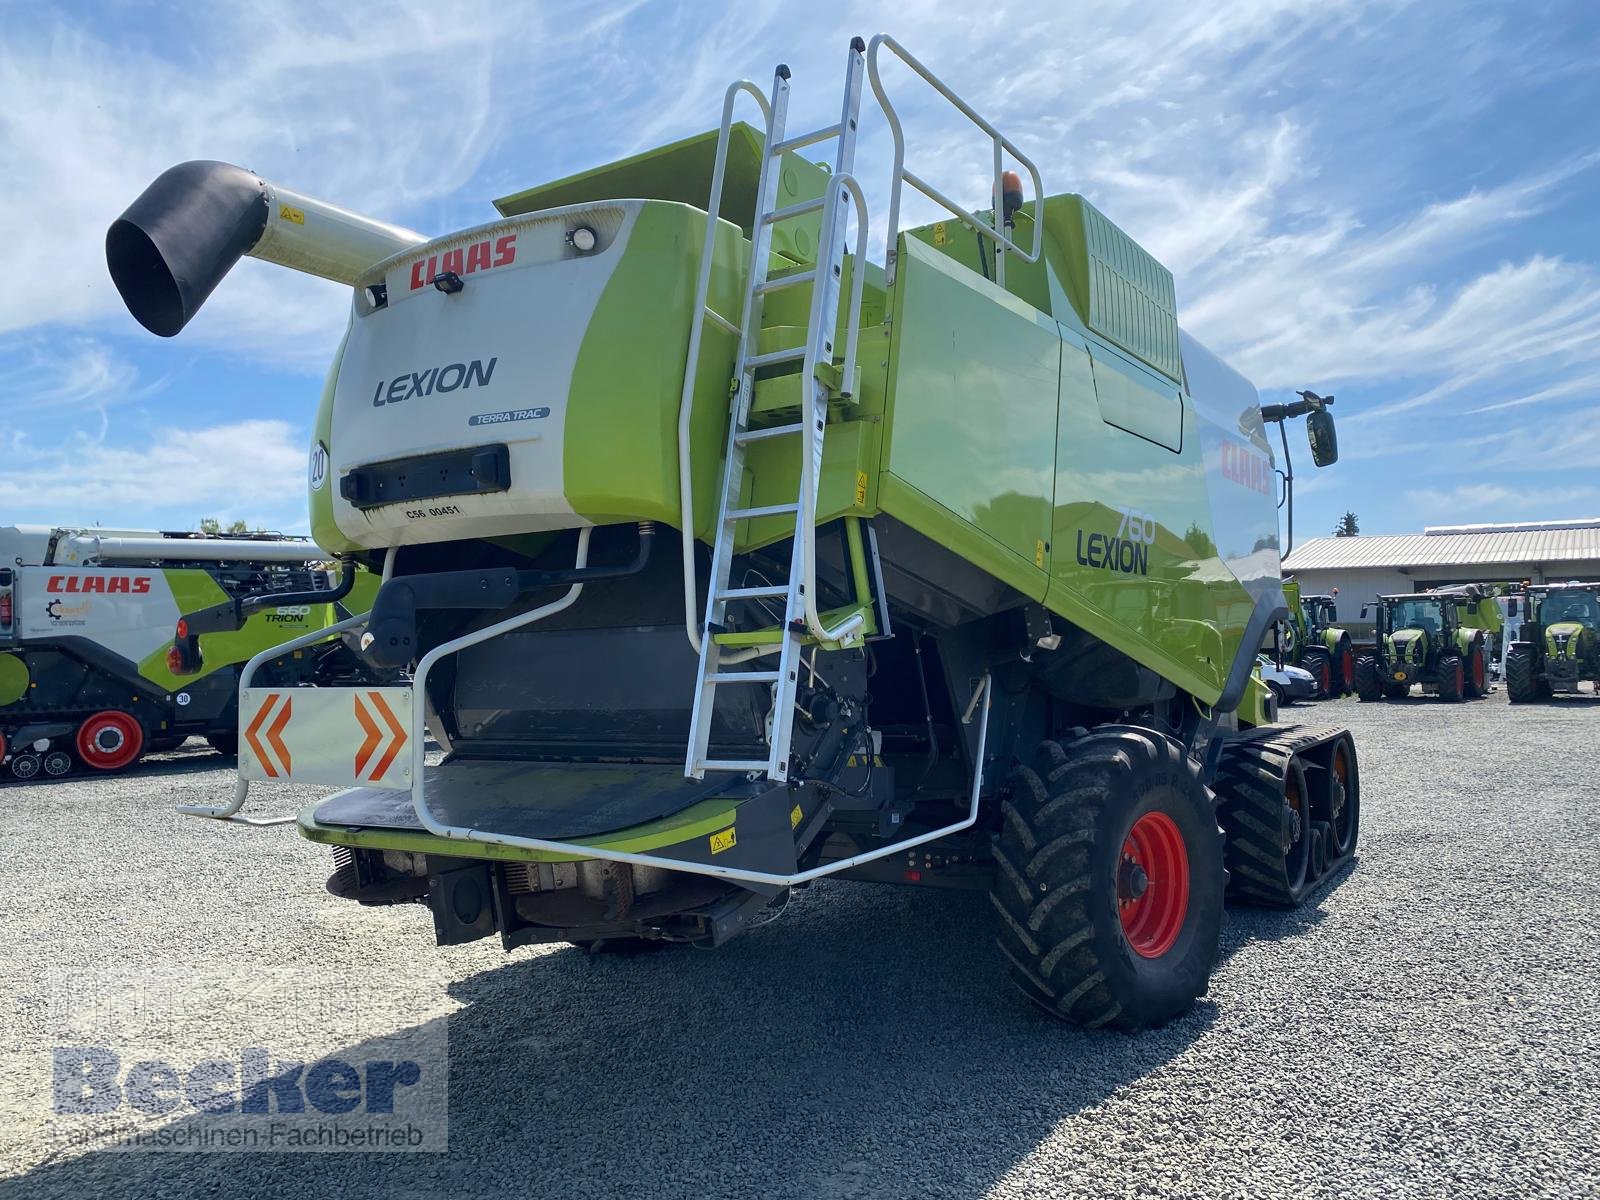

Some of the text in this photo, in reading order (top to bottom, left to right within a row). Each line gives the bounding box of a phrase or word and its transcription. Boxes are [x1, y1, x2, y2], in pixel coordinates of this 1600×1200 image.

[410, 234, 517, 290] CLAAS
[373, 356, 498, 407] LEXION
[477, 408, 542, 424] TERRA TRAC
[312, 448, 324, 482] 20
[1221, 439, 1271, 496] CLAAS
[406, 505, 461, 519] C56 00451
[1115, 505, 1156, 545] 760
[1076, 528, 1148, 577] LEXION
[46, 575, 152, 593] CLAAS
[265, 614, 305, 623] TRION
[276, 605, 311, 615] 660
[178, 694, 189, 704] 30
